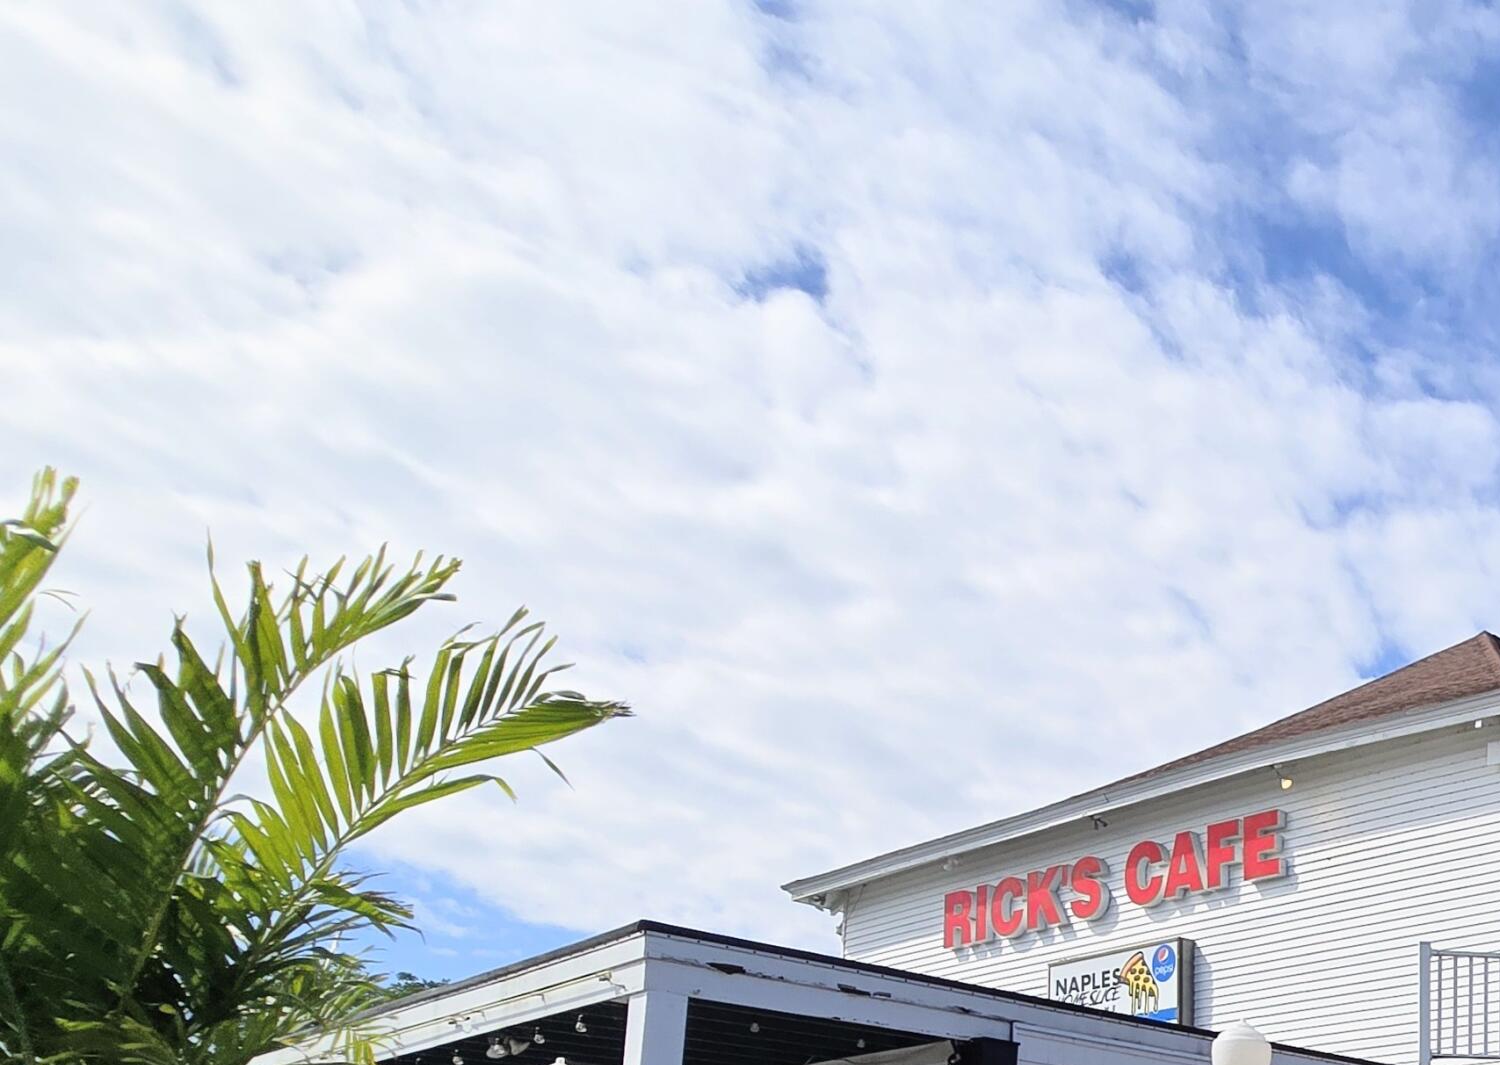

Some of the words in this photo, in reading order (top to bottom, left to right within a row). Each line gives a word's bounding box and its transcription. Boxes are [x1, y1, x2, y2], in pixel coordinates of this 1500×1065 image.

[943, 855, 1109, 949] RICK'S
[1125, 809, 1285, 907] CAFE
[1055, 968, 1121, 996] NAPLES
